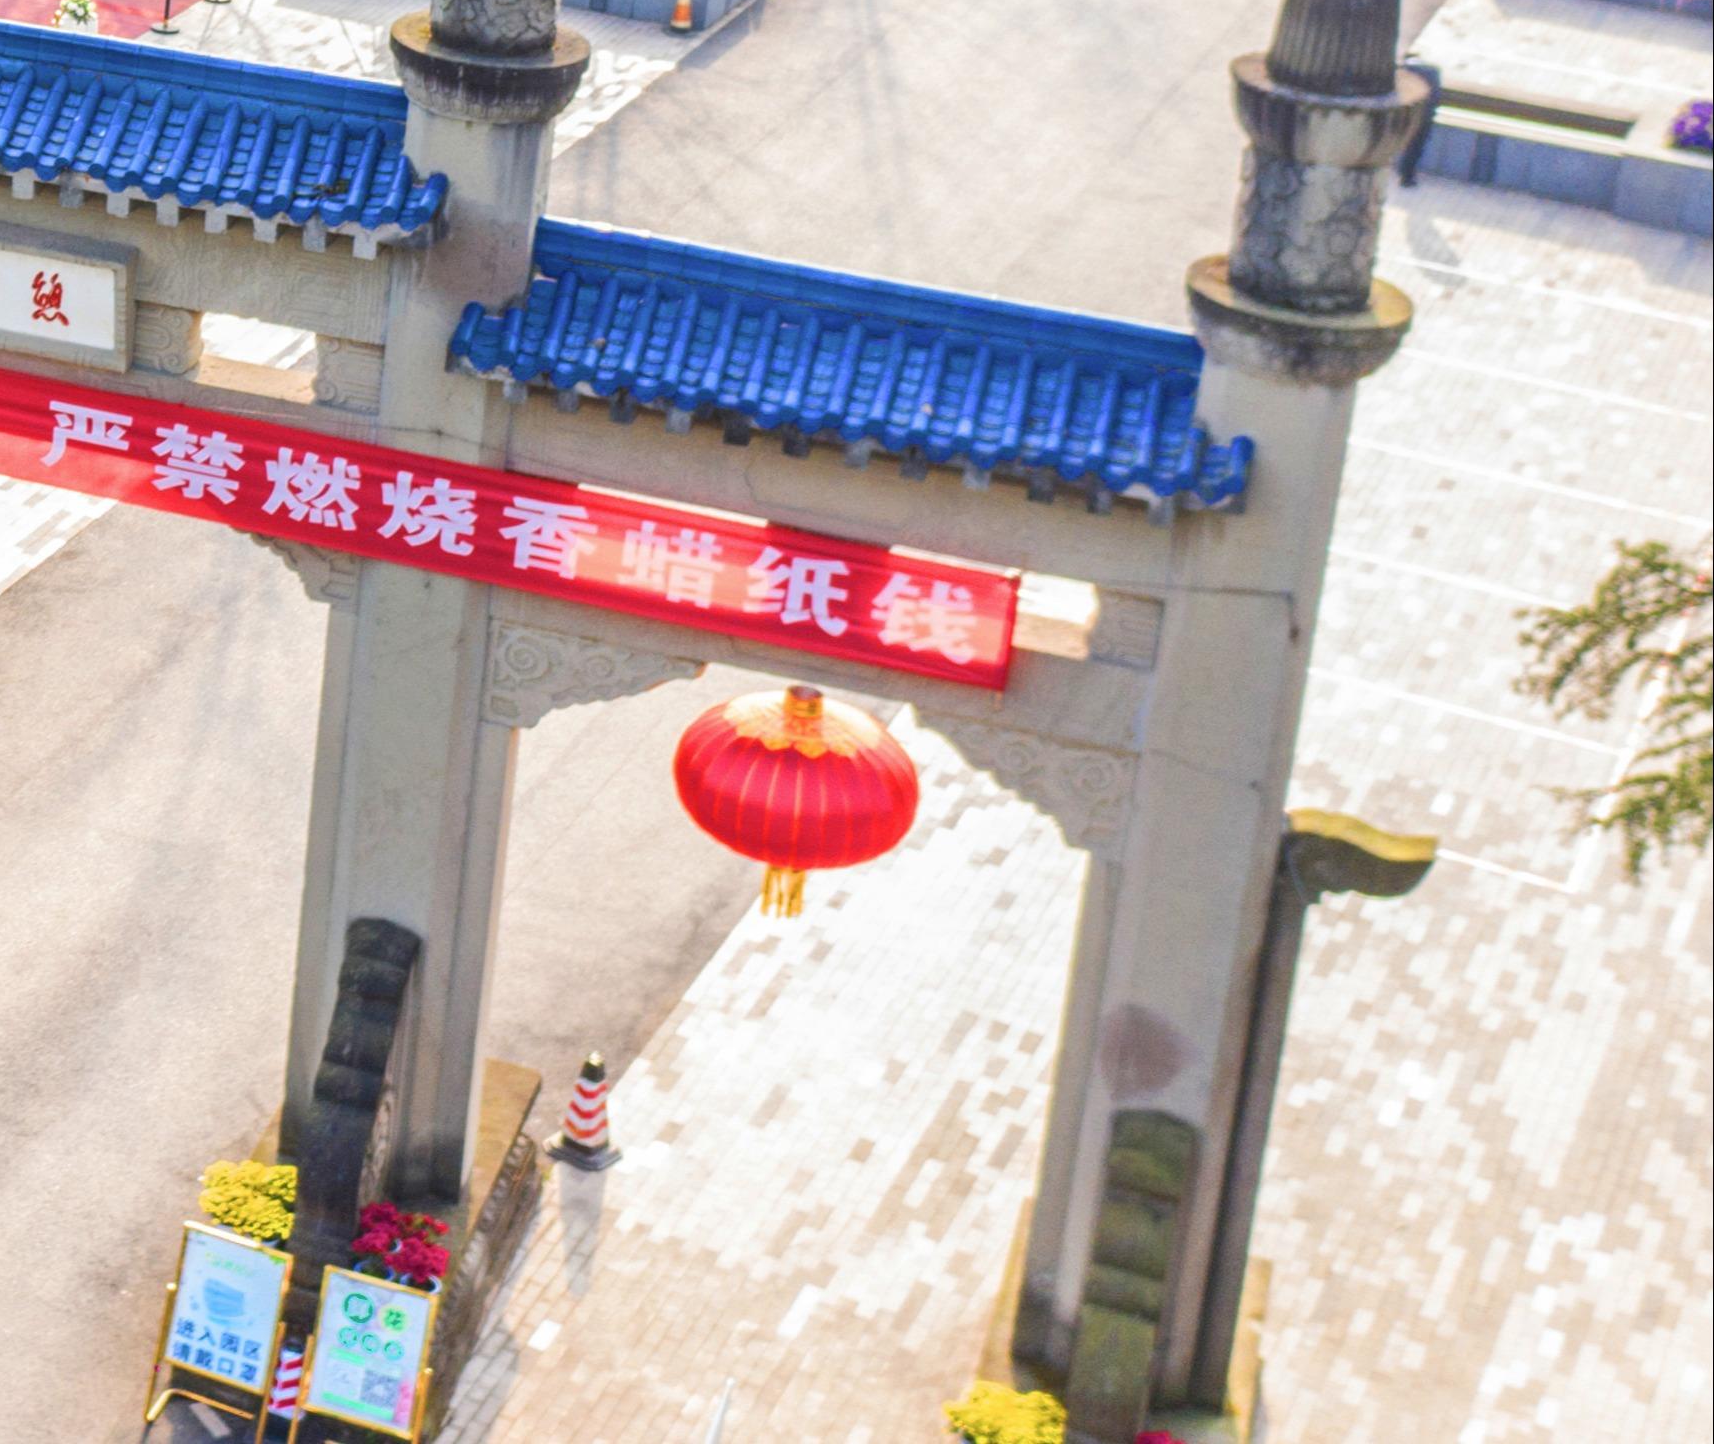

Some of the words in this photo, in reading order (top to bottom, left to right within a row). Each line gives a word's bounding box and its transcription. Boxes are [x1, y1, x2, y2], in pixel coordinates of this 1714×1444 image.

[42, 400, 980, 667] 严禁燃烧香蜡纸钱
[177, 1318, 262, 1360] 进入园区
